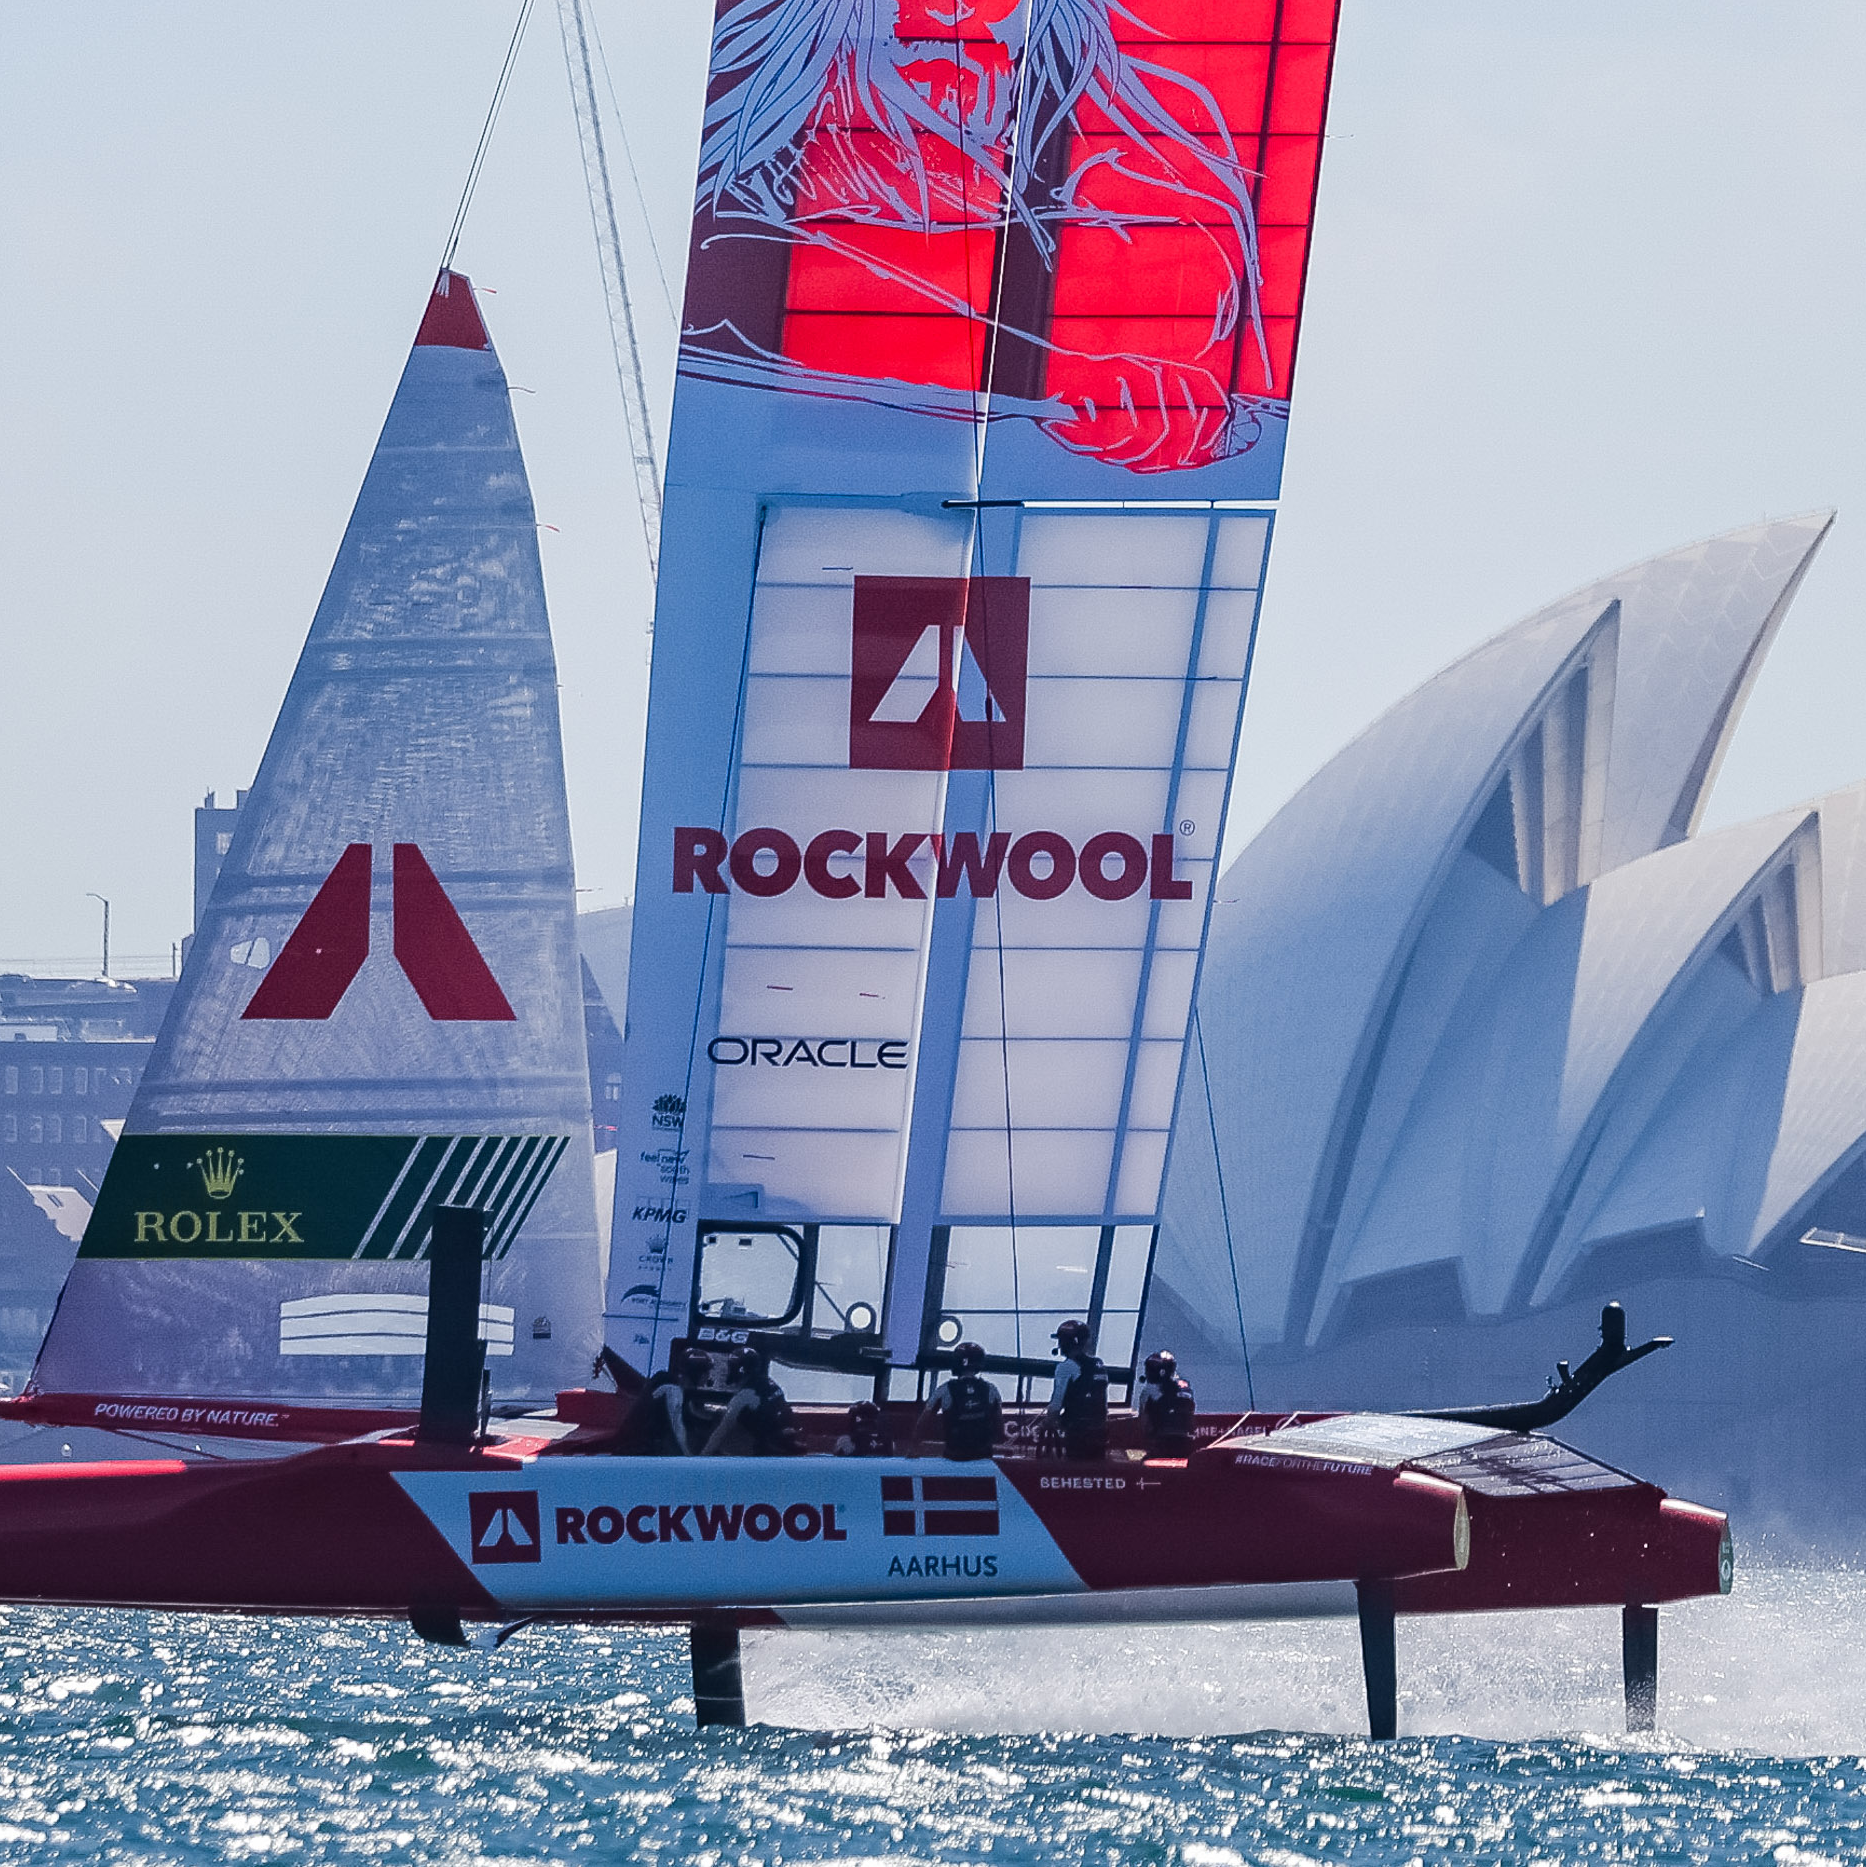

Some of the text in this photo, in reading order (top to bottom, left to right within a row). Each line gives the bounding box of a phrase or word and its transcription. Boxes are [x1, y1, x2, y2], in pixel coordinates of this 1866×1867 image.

[706, 1036, 909, 1070] ORACLE
[652, 1115, 685, 1128] NSW
[632, 1206, 687, 1224] KPMG
[134, 1210, 305, 1244] ROLEX
[697, 1327, 750, 1344] B&G
[94, 1403, 179, 1422] POWERED
[181, 1408, 206, 1423] BY
[888, 1555, 999, 1578] AARHUS
